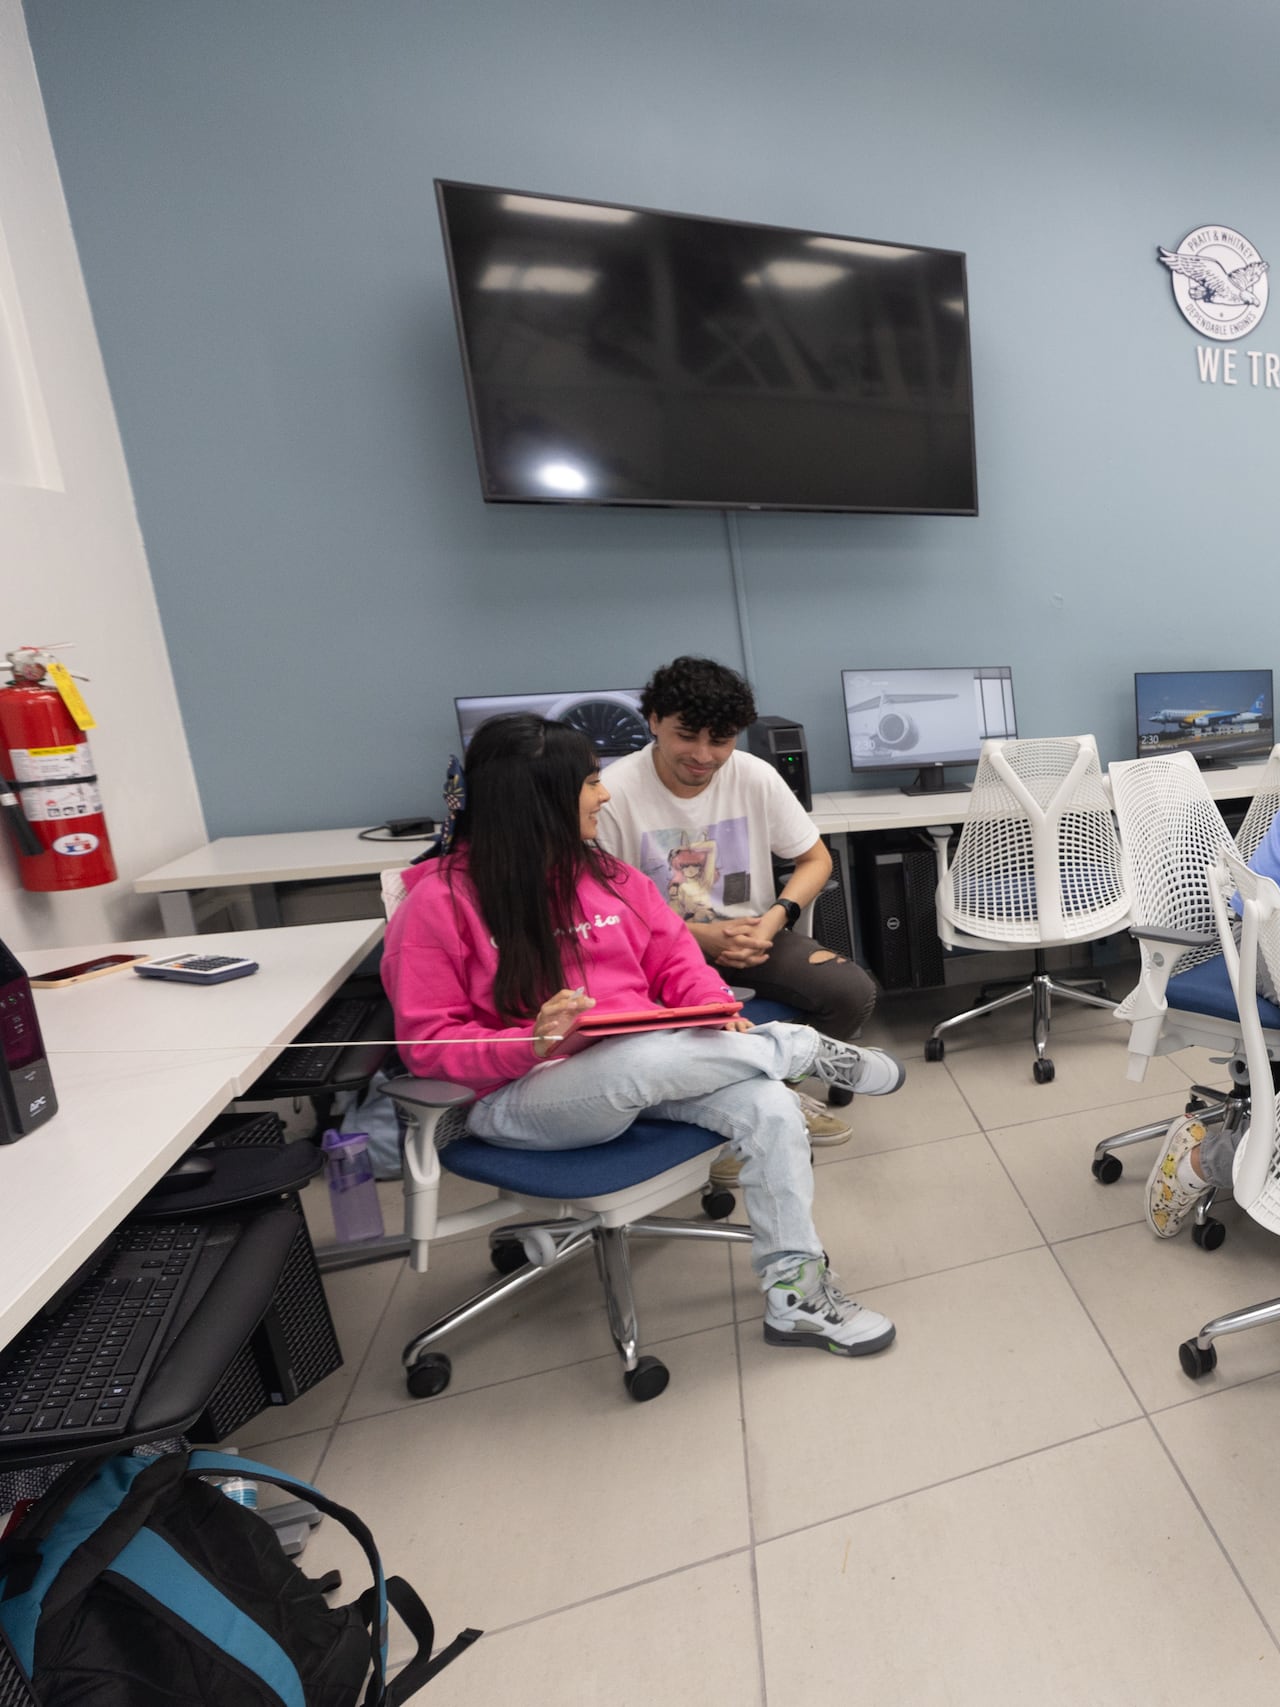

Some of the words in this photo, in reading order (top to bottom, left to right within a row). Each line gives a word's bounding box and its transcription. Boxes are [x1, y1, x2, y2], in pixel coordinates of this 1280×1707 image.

[1187, 231, 1211, 252] PRATT
[1213, 230, 1219, 241] &
[1221, 231, 1254, 259] WHITNEY
[1185, 304, 1227, 336] DEPENDABLE
[1230, 312, 1257, 335] ENGINES
[1197, 345, 1238, 385] WE
